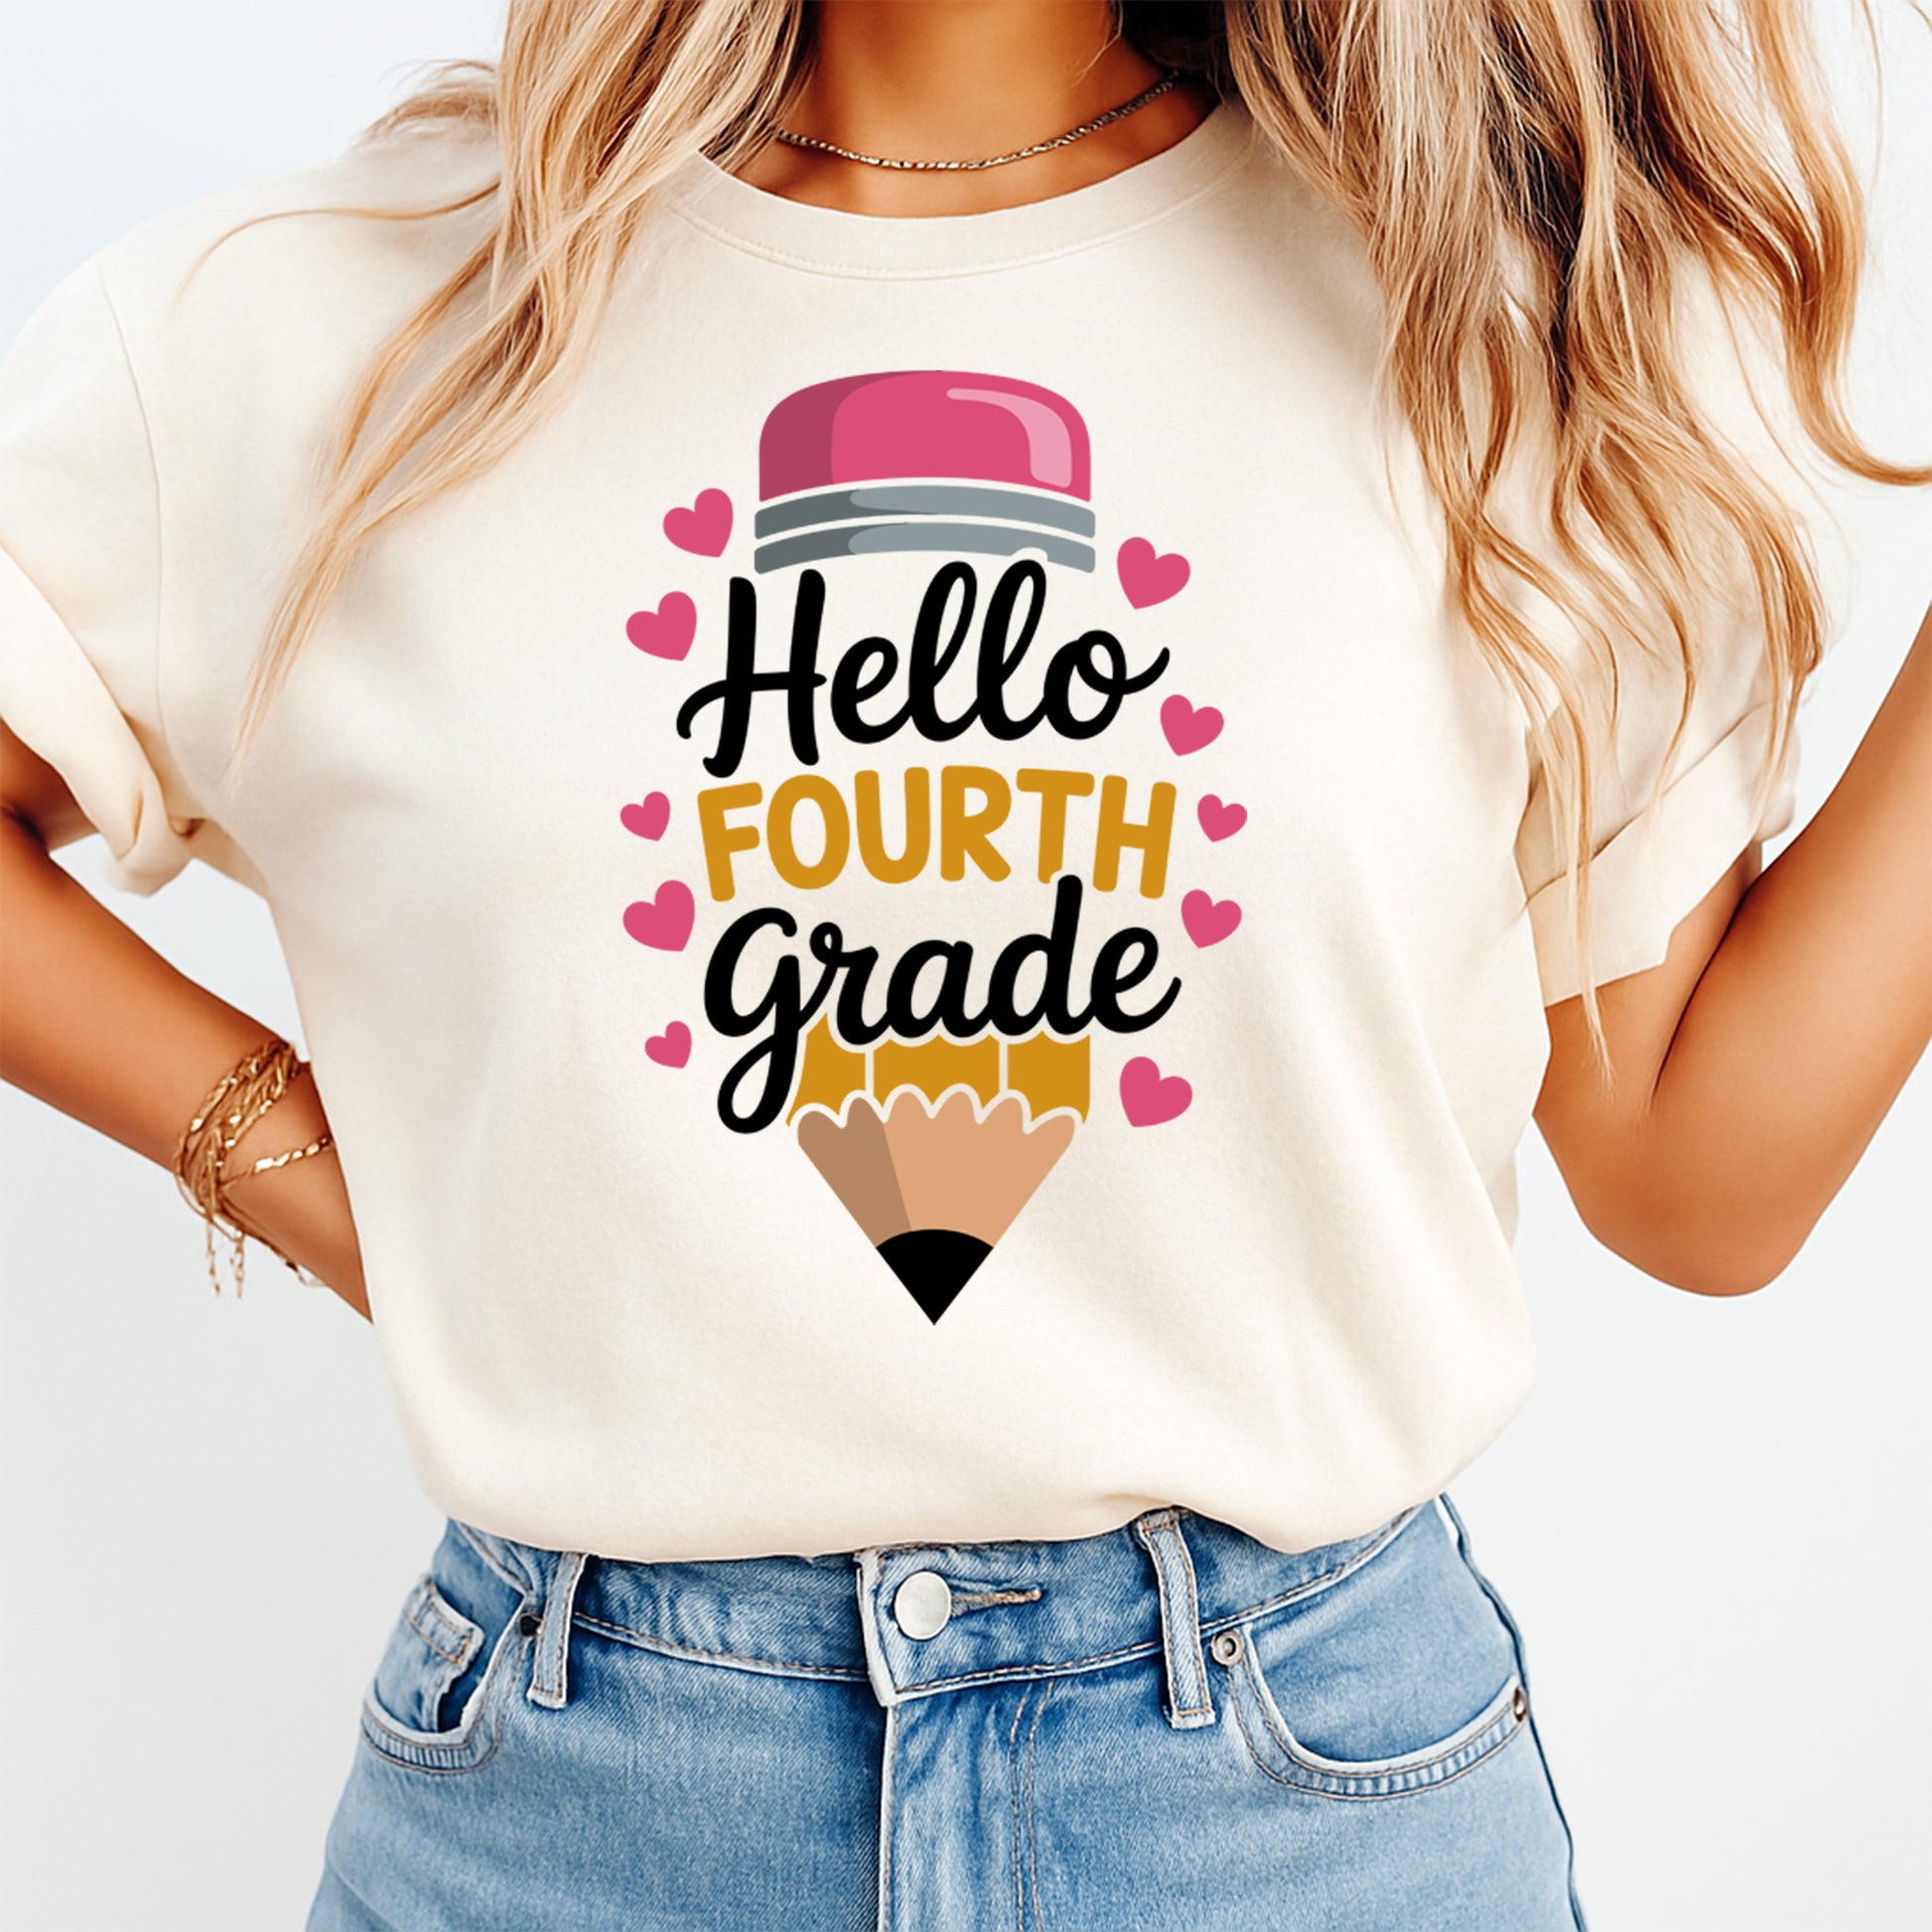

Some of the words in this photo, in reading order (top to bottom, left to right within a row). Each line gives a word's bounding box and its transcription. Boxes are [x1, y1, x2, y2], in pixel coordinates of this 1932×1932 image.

[677, 560, 1170, 777] Hello
[698, 766, 1176, 901] FOURTH
[705, 875, 1181, 1133] Grade
